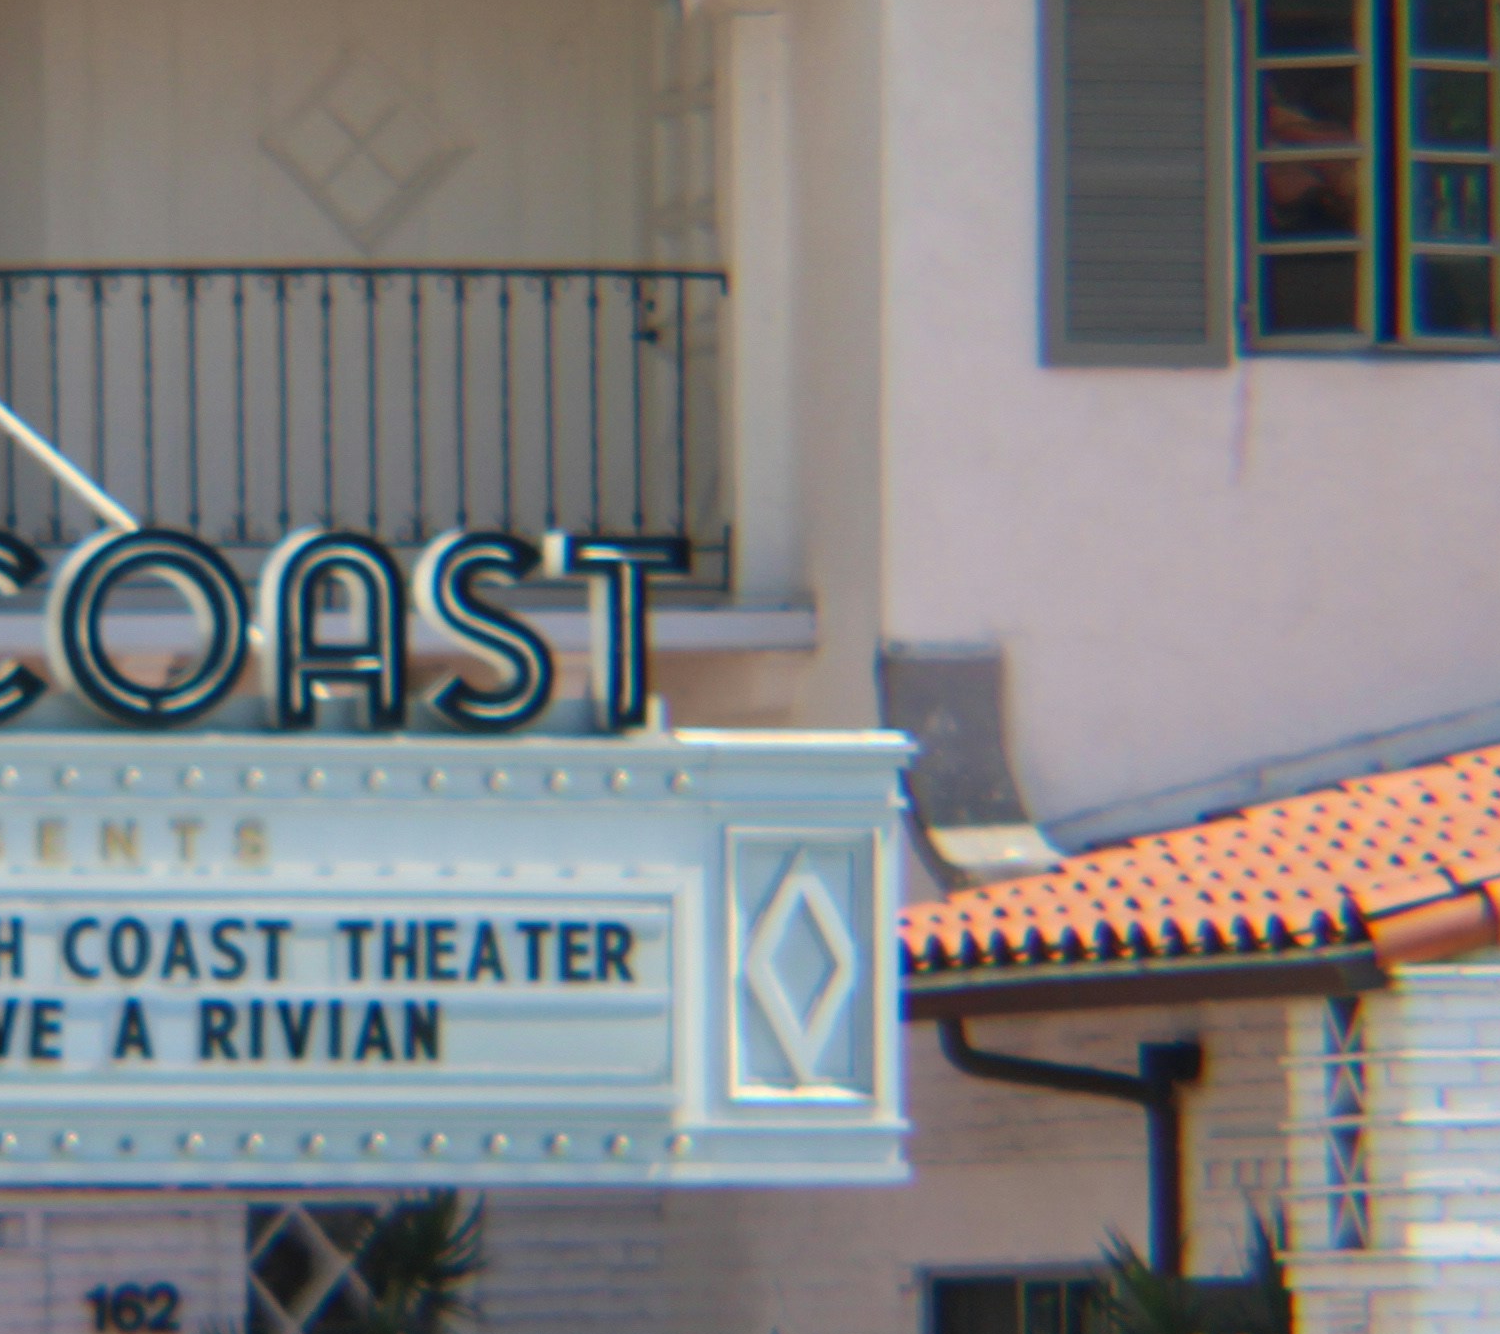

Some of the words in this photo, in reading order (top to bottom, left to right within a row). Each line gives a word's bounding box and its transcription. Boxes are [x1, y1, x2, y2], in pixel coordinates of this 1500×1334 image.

[62, 917, 289, 981] COAST
[339, 919, 633, 983] THEATER
[113, 999, 155, 1059] A
[200, 1000, 441, 1061] RIVIAN
[85, 1281, 181, 1333] 162
